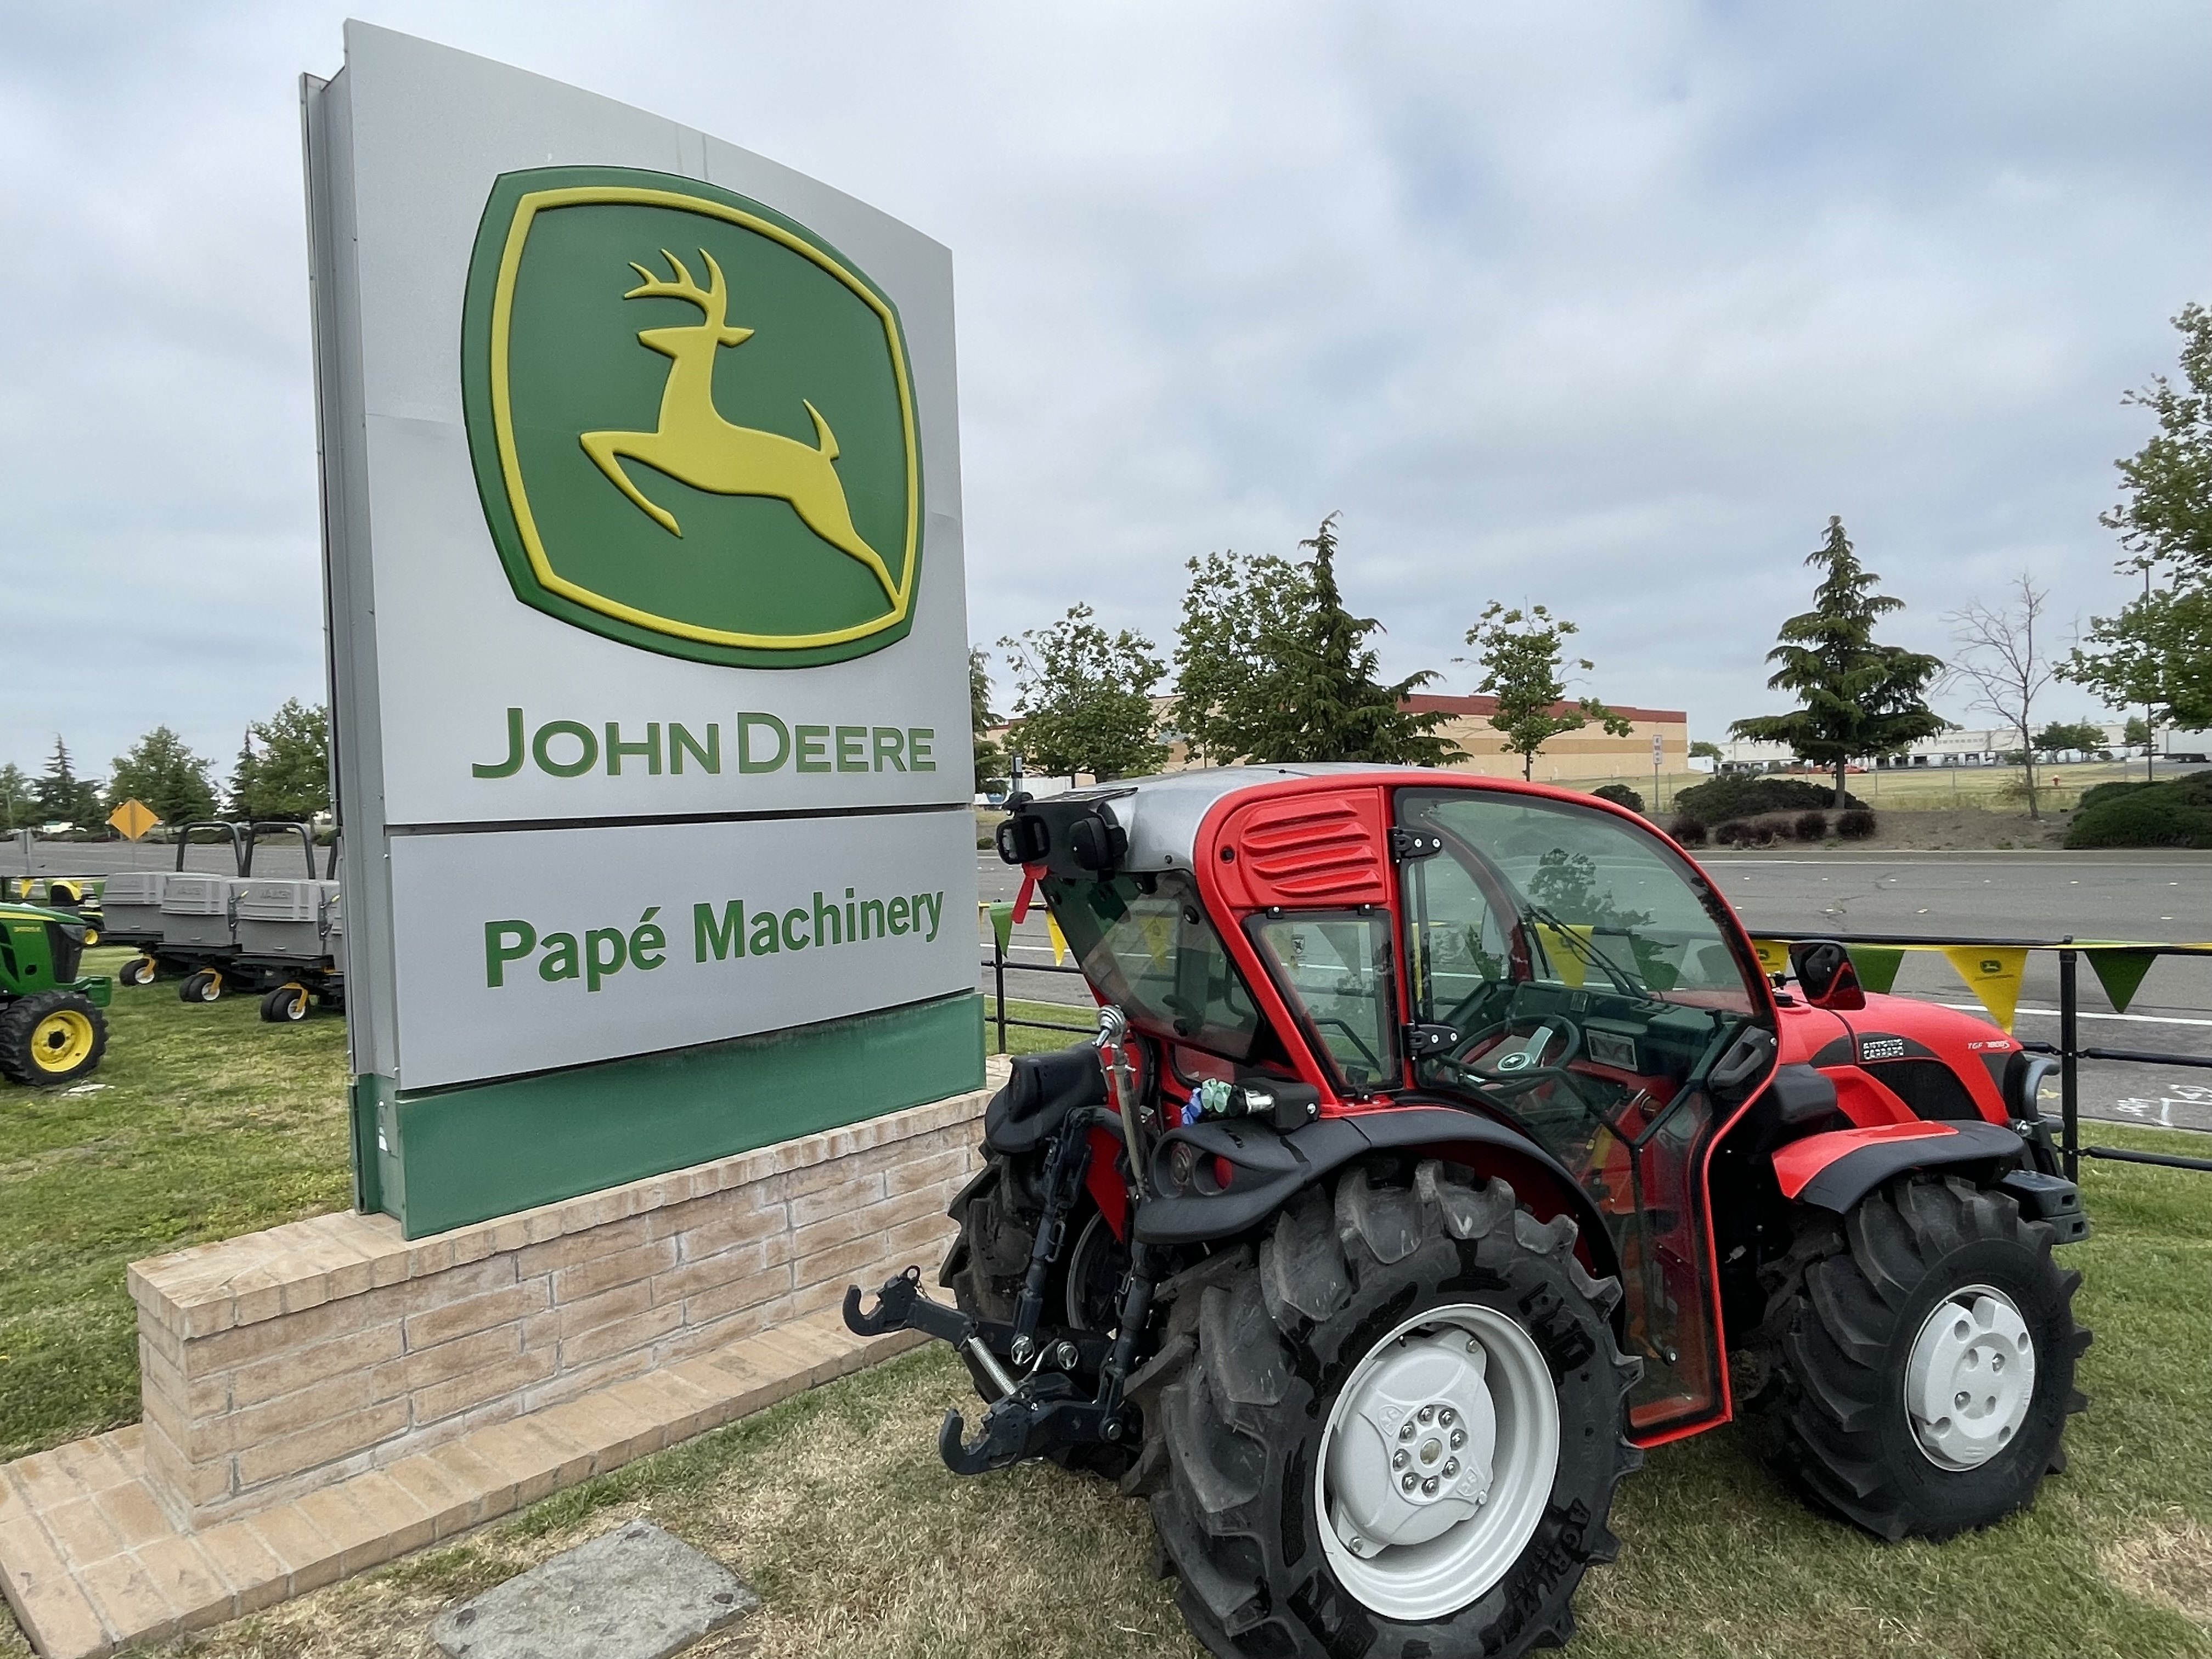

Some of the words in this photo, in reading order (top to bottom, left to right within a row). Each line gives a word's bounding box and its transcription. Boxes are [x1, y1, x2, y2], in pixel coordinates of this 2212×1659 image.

[472, 707, 721, 778] JOHN
[737, 712, 936, 774] DEERE
[484, 906, 666, 992] Papé
[693, 887, 944, 964] Machinery
